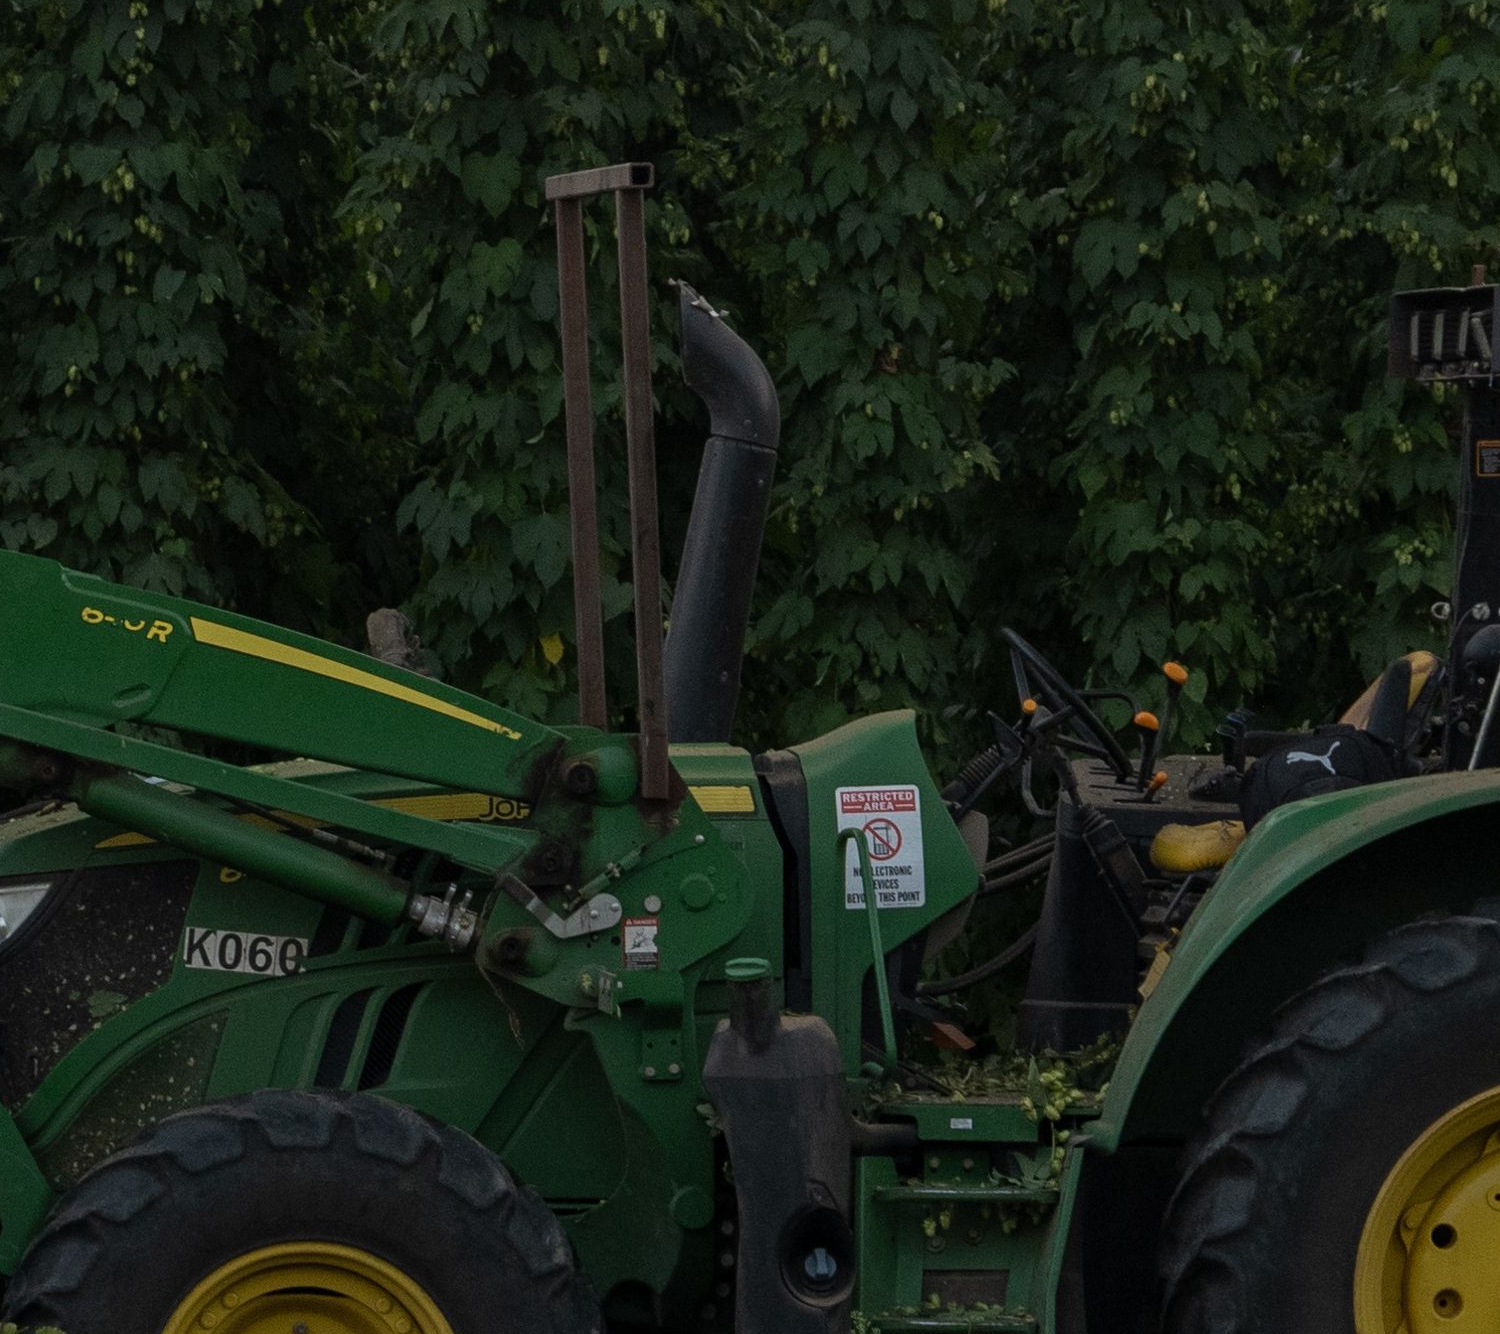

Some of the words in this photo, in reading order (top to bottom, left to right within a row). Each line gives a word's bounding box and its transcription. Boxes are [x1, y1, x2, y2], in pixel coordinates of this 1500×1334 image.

[842, 791, 913, 803] RESTRICTED
[863, 802, 895, 812] AREA
[871, 865, 912, 877] LECTRONIC
[873, 879, 899, 890] EVICES
[879, 892, 896, 903] THIS
[898, 891, 920, 902] POINT
